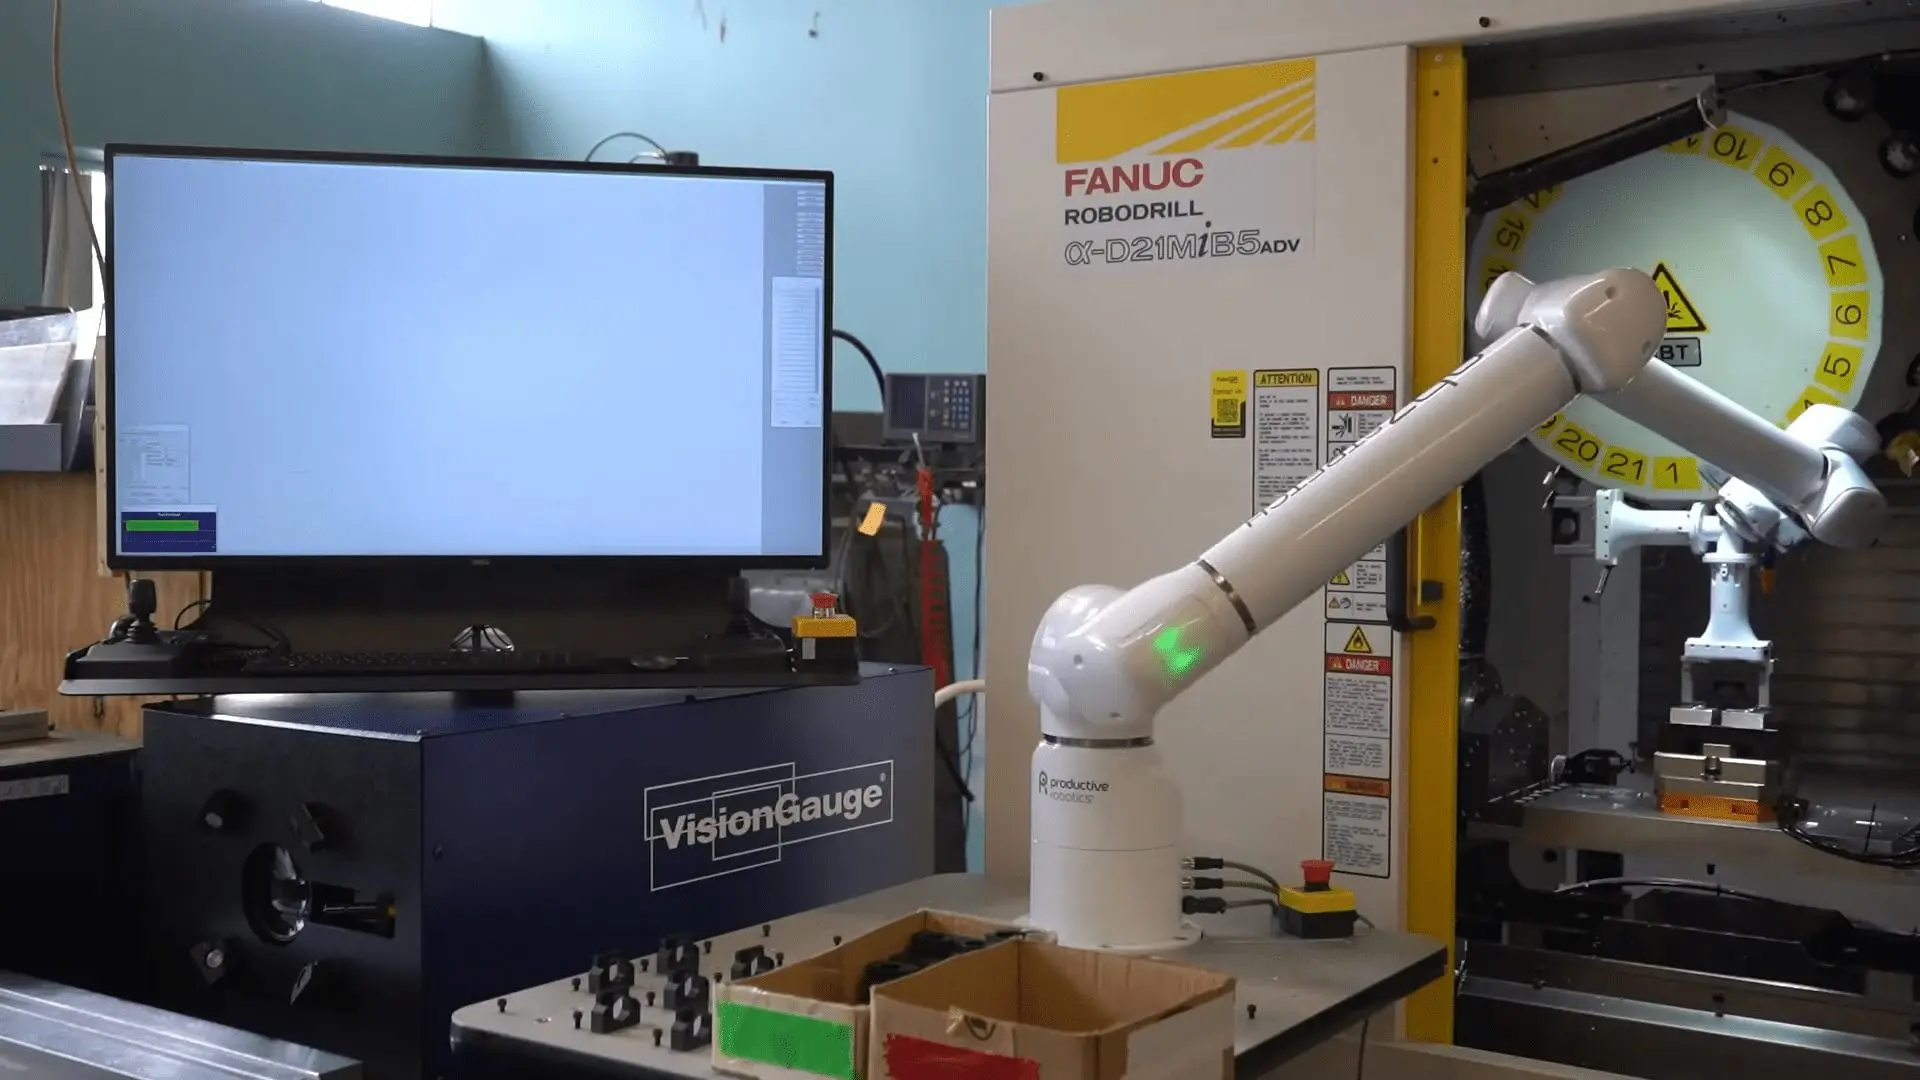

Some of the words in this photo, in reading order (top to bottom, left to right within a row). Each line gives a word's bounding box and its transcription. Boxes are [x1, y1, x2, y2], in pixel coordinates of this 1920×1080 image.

[1713, 131, 1748, 161] 10
[1064, 158, 1204, 197] FANUC
[1064, 200, 1204, 226] ROBODRILL
[1804, 200, 1833, 226] 8
[1496, 218, 1525, 252] 15
[1826, 254, 1857, 276] 7
[1656, 344, 1689, 361] BT
[1823, 354, 1851, 377] 5
[1259, 372, 1313, 385] ATTENTION
[1350, 393, 1388, 407] DANGER
[1556, 428, 1599, 462] 20
[1606, 452, 1644, 480] 21
[1666, 461, 1678, 485] 1
[1345, 658, 1379, 672] DANGER
[1050, 778, 1110, 792] productive
[659, 784, 884, 850] VisionGauge
